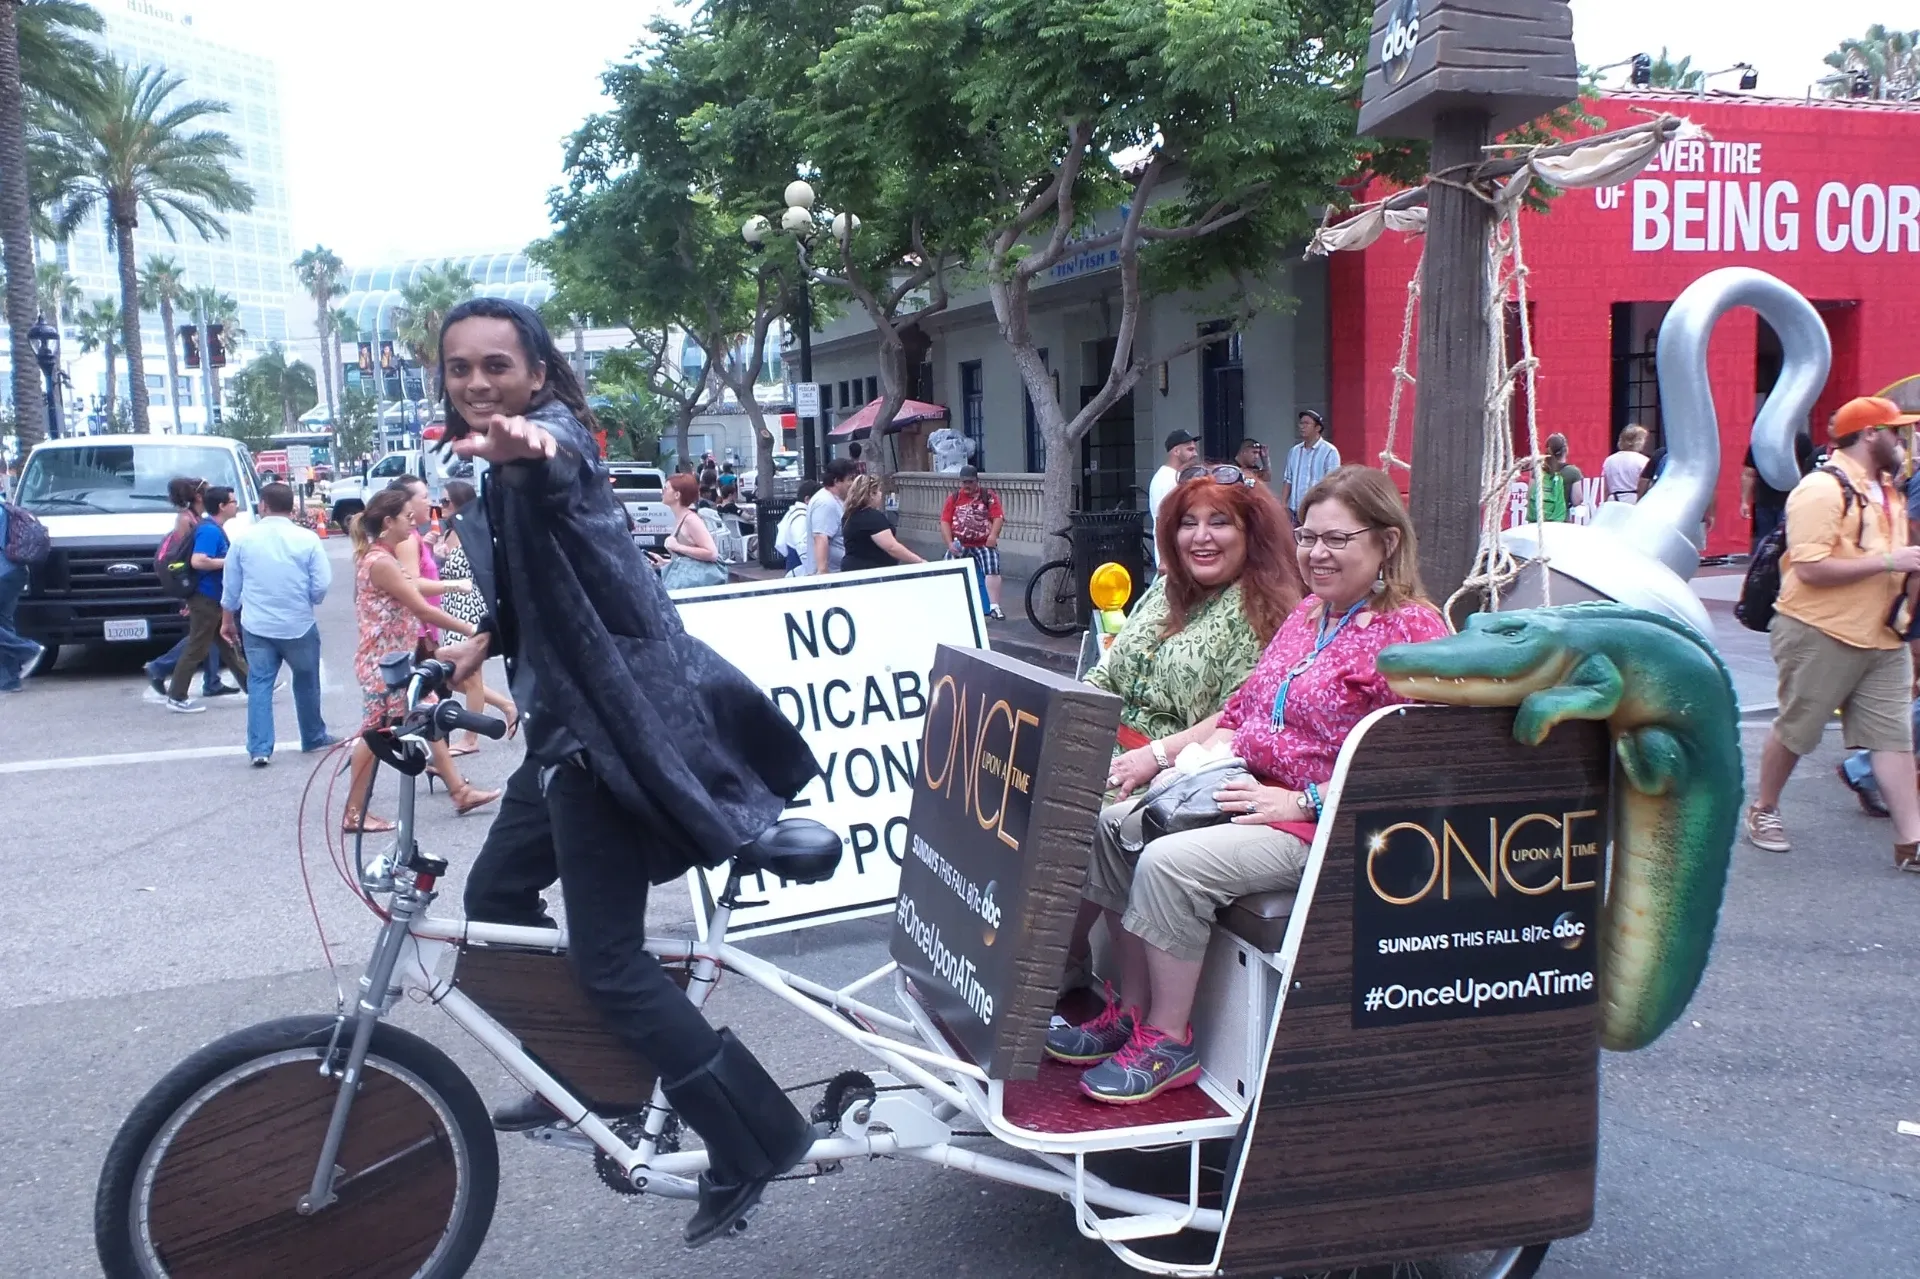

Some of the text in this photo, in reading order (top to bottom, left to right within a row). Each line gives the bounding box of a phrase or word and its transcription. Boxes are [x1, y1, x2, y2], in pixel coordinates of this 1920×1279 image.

[1382, 18, 1419, 62] abc
[1709, 142, 1762, 174] TIRE
[1595, 179, 1920, 254] OF BEING COR
[1080, 252, 1105, 269] FISH
[784, 606, 857, 661] NO
[770, 669, 932, 732] DICAB
[815, 740, 920, 803] YON
[924, 674, 1040, 852] ONCE
[982, 750, 1031, 794] UPON A TIME
[1366, 809, 1598, 905] ONCE
[1512, 842, 1598, 862] UPON A TIME
[912, 833, 940, 874] SUNDAYS
[938, 856, 953, 886] THIS
[951, 868, 967, 901] FALL
[981, 893, 1001, 929] abc
[897, 893, 994, 1025] #OnceUponATime
[1378, 934, 1449, 954] SUNDAYS
[1452, 931, 1483, 948] THIS
[1487, 928, 1519, 945] FALL
[1553, 919, 1586, 939] abc
[1364, 968, 1594, 1011] #OnceUponATime
